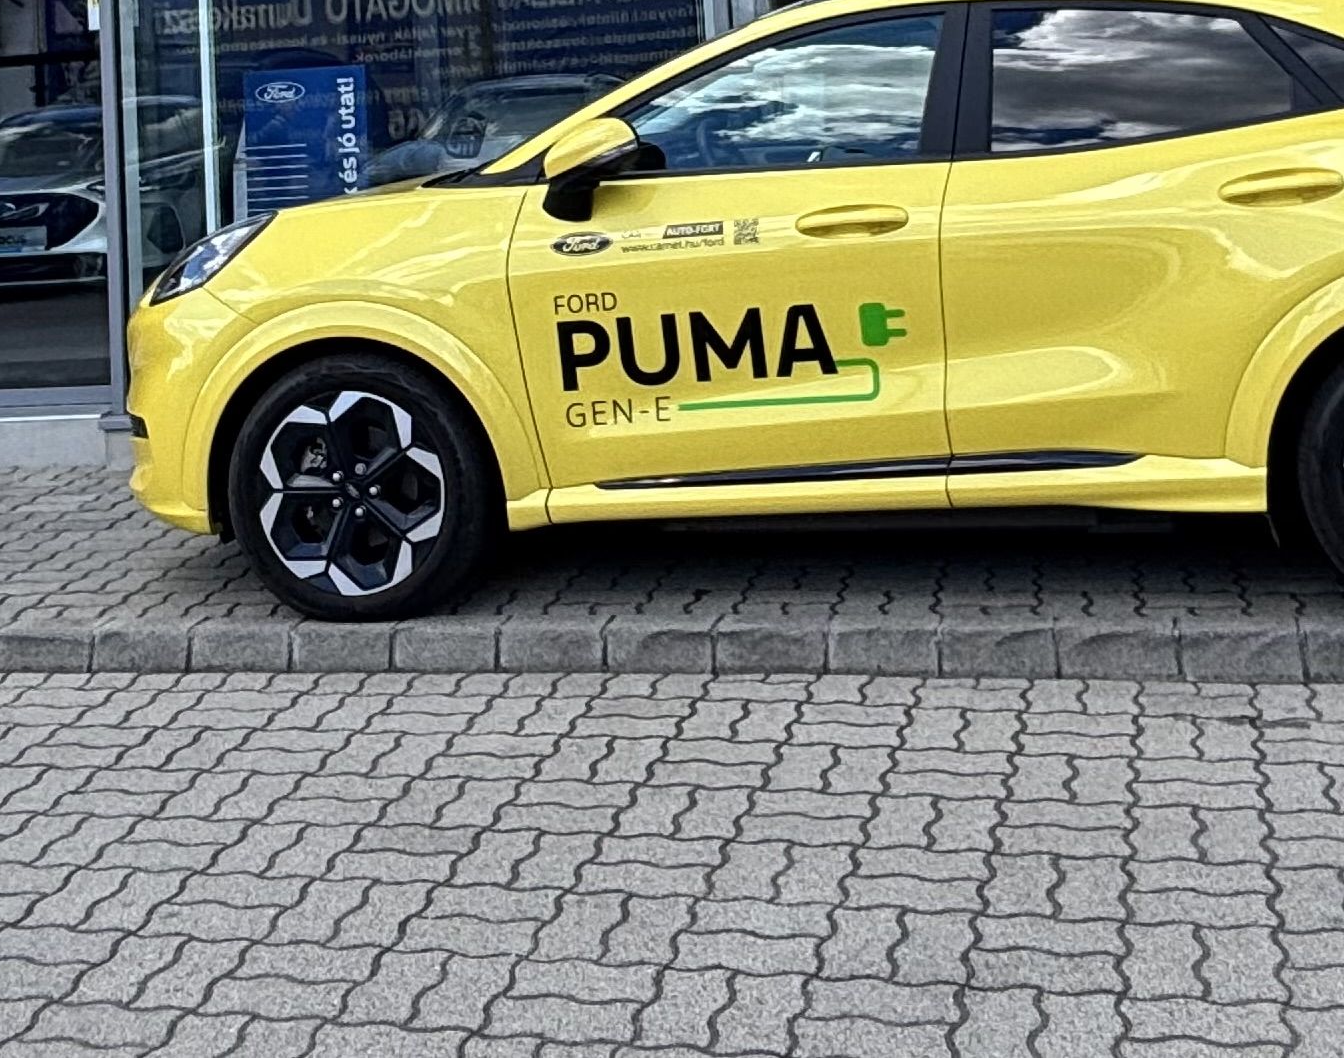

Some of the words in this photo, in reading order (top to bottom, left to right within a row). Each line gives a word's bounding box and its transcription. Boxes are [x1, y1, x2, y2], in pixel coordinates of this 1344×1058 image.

[336, 76, 356, 129] utat!
[336, 132, 360, 153] jó
[338, 156, 358, 183] és
[554, 292, 618, 315] FORD
[556, 303, 839, 392] PUMA
[565, 395, 672, 428] GEN-E
